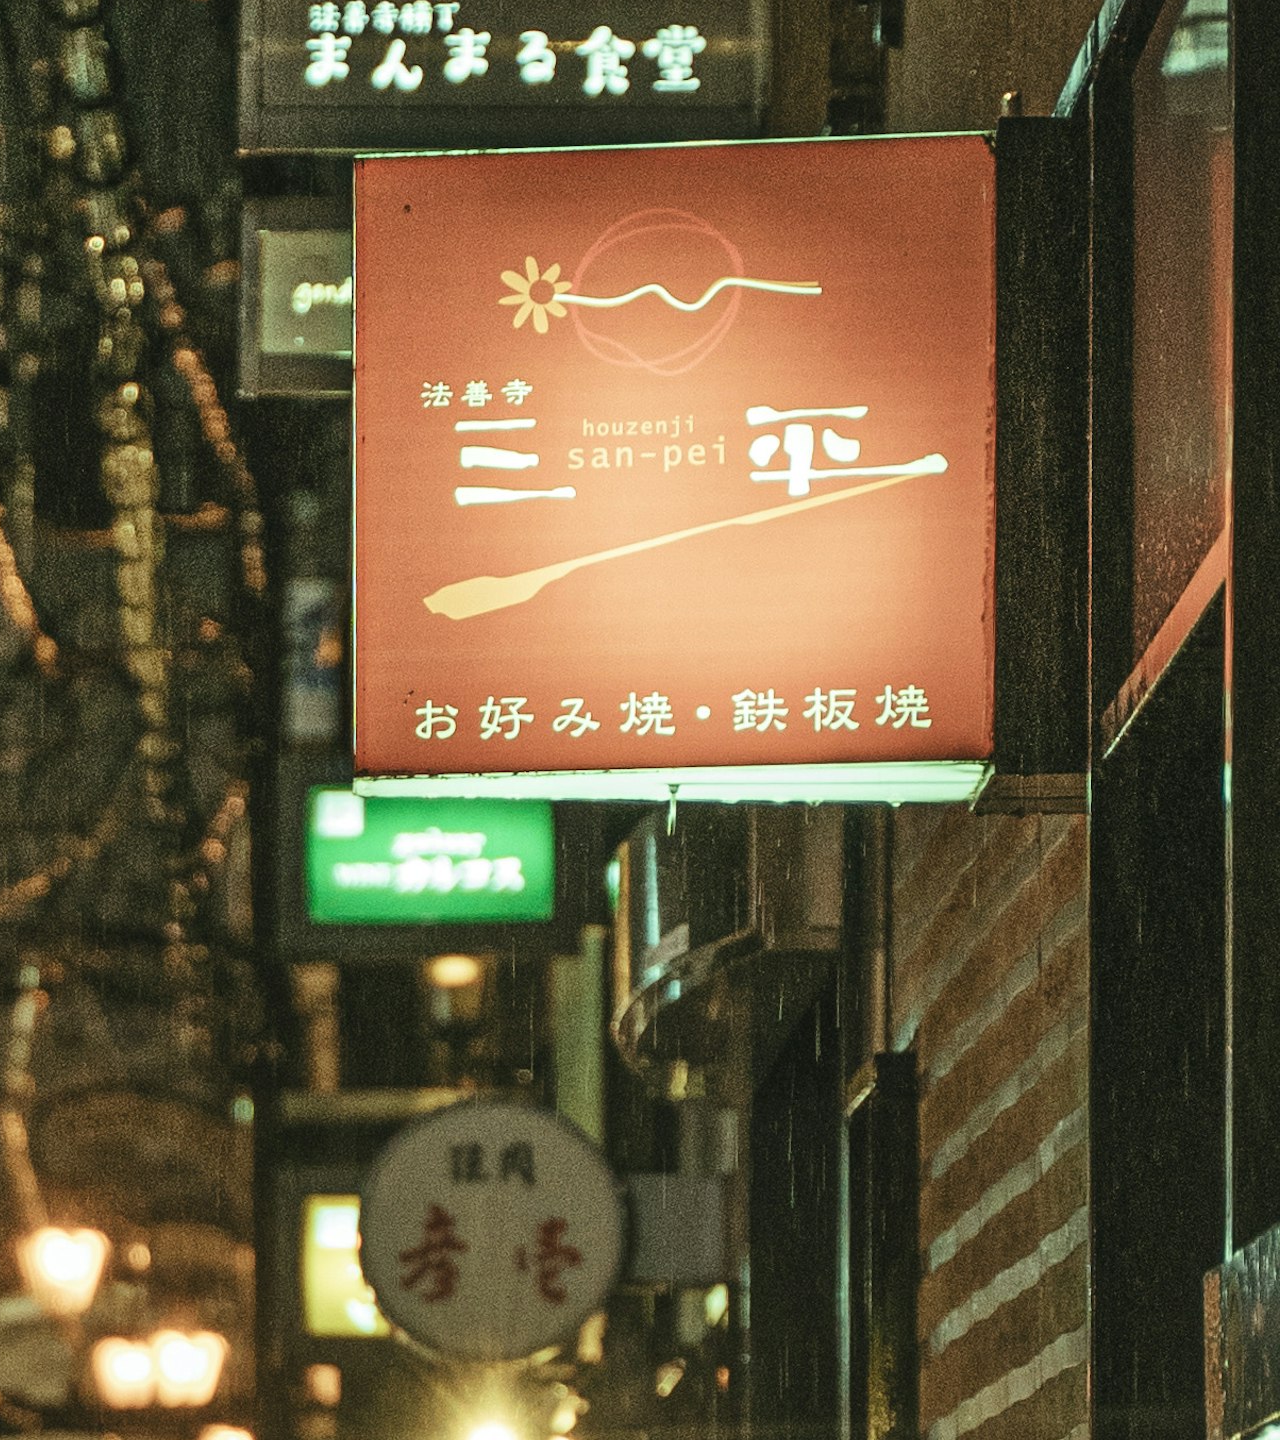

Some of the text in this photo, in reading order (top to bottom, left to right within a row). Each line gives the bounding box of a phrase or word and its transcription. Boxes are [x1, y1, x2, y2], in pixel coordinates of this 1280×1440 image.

[304, 25, 708, 97] まんまる食堂
[420, 378, 533, 408] 法善寺
[581, 414, 696, 438] houzenji
[567, 434, 727, 473] san-pei
